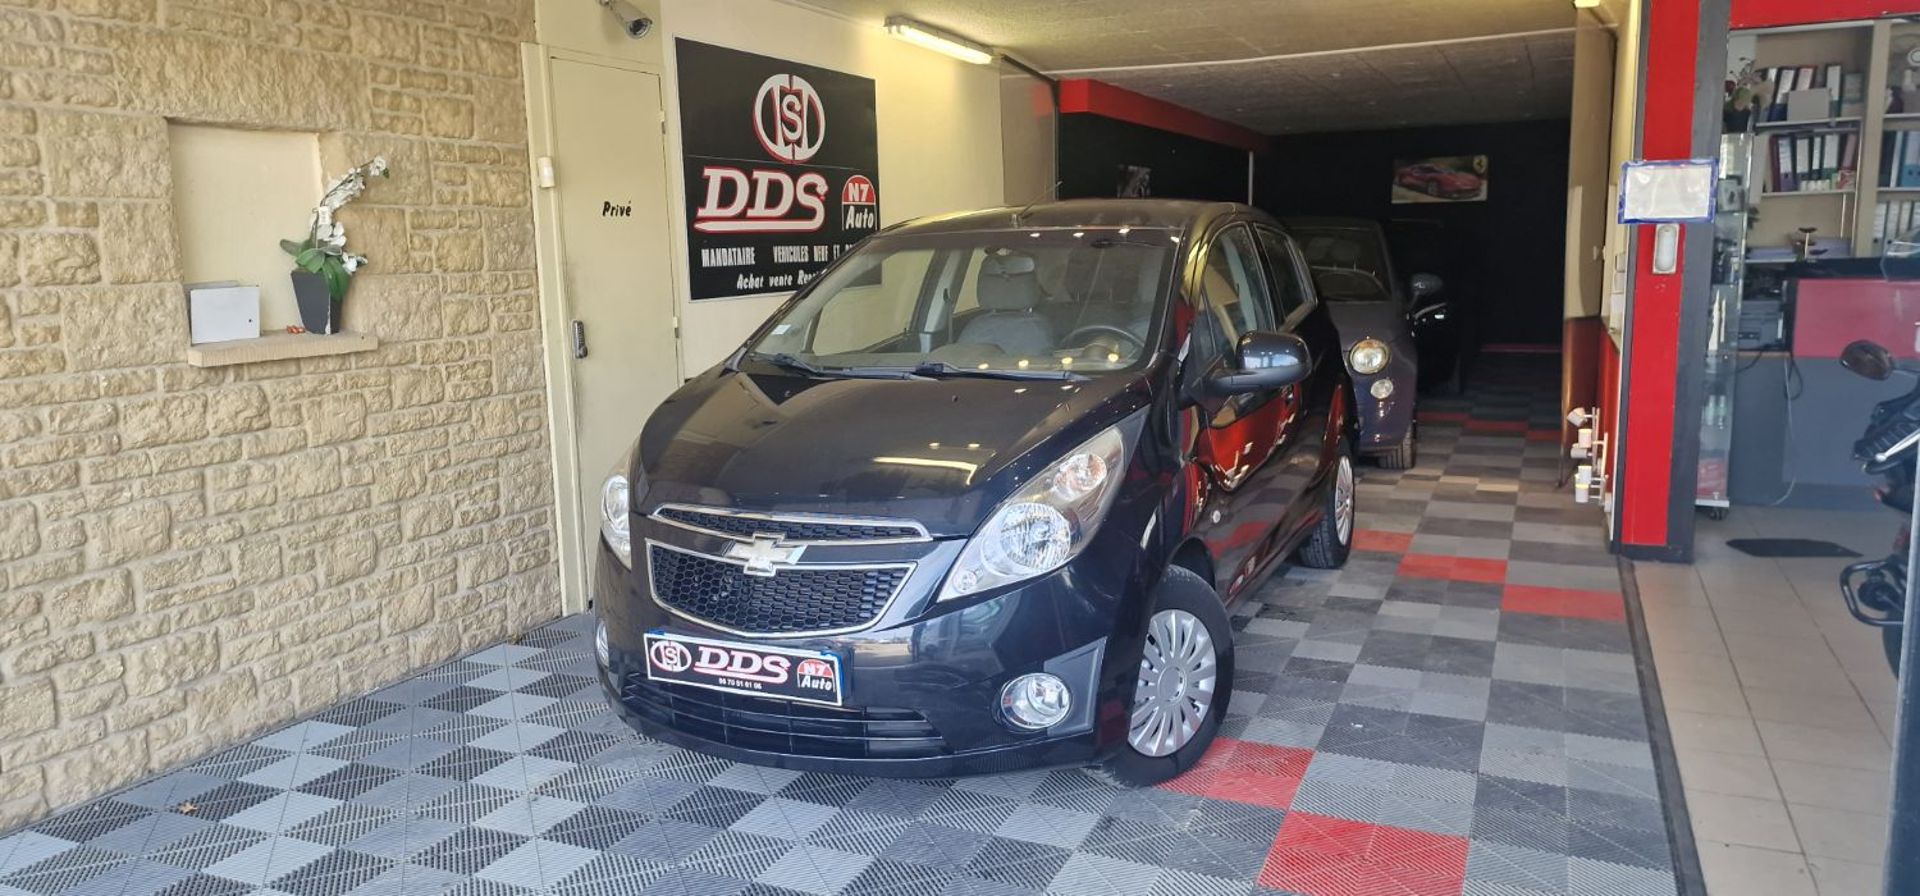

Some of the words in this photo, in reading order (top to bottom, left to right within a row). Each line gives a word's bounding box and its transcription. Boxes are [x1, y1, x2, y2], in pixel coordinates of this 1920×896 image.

[694, 166, 828, 232] DDS
[848, 182, 869, 203] N7
[602, 200, 631, 217] Privé
[845, 205, 875, 229] Auto
[701, 246, 756, 268] MANDATAIRE
[773, 245, 809, 263] VEHICULES
[736, 273, 764, 290] Achat
[769, 274, 793, 287] vente
[693, 646, 791, 685] DDS
[803, 662, 826, 676] N7
[800, 675, 832, 691] Auto
